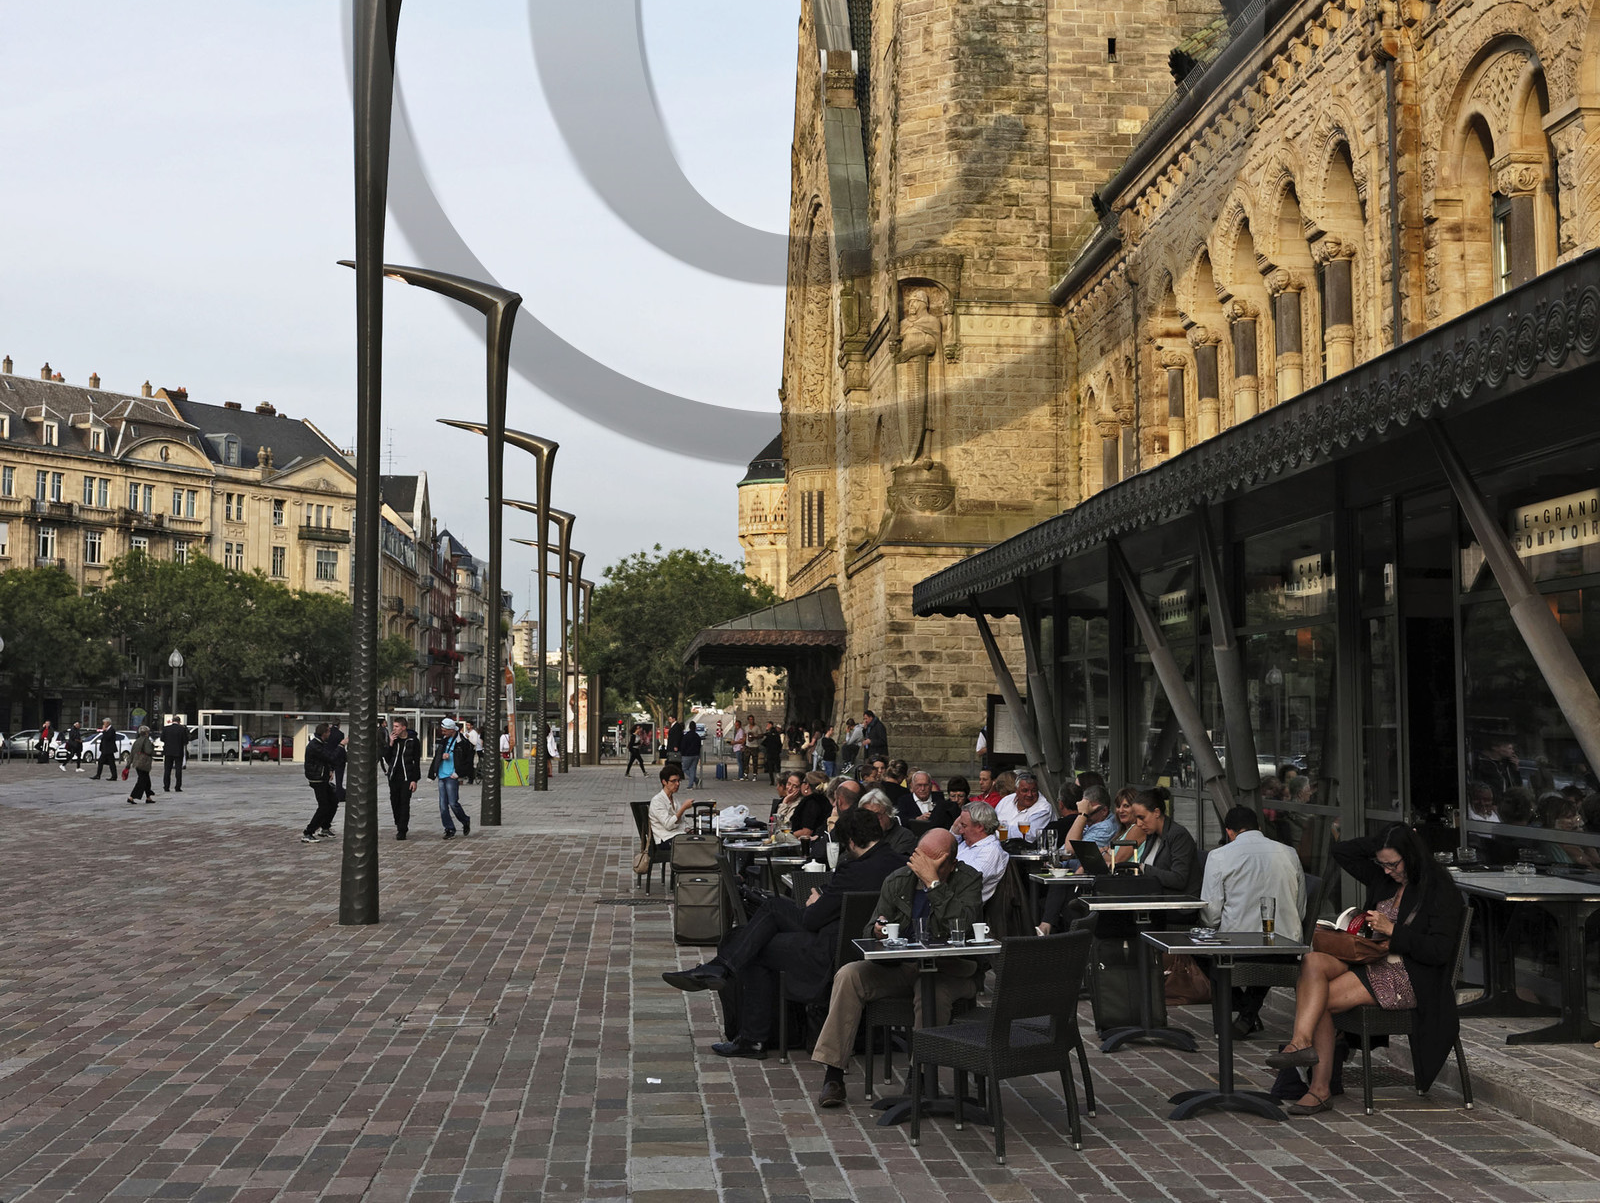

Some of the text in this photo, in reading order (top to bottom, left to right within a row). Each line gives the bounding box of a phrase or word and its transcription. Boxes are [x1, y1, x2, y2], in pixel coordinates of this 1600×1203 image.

[1543, 498, 1598, 524] GRAND
[1515, 520, 1598, 552] COMPTOIR
[1299, 560, 1321, 575] CAF
